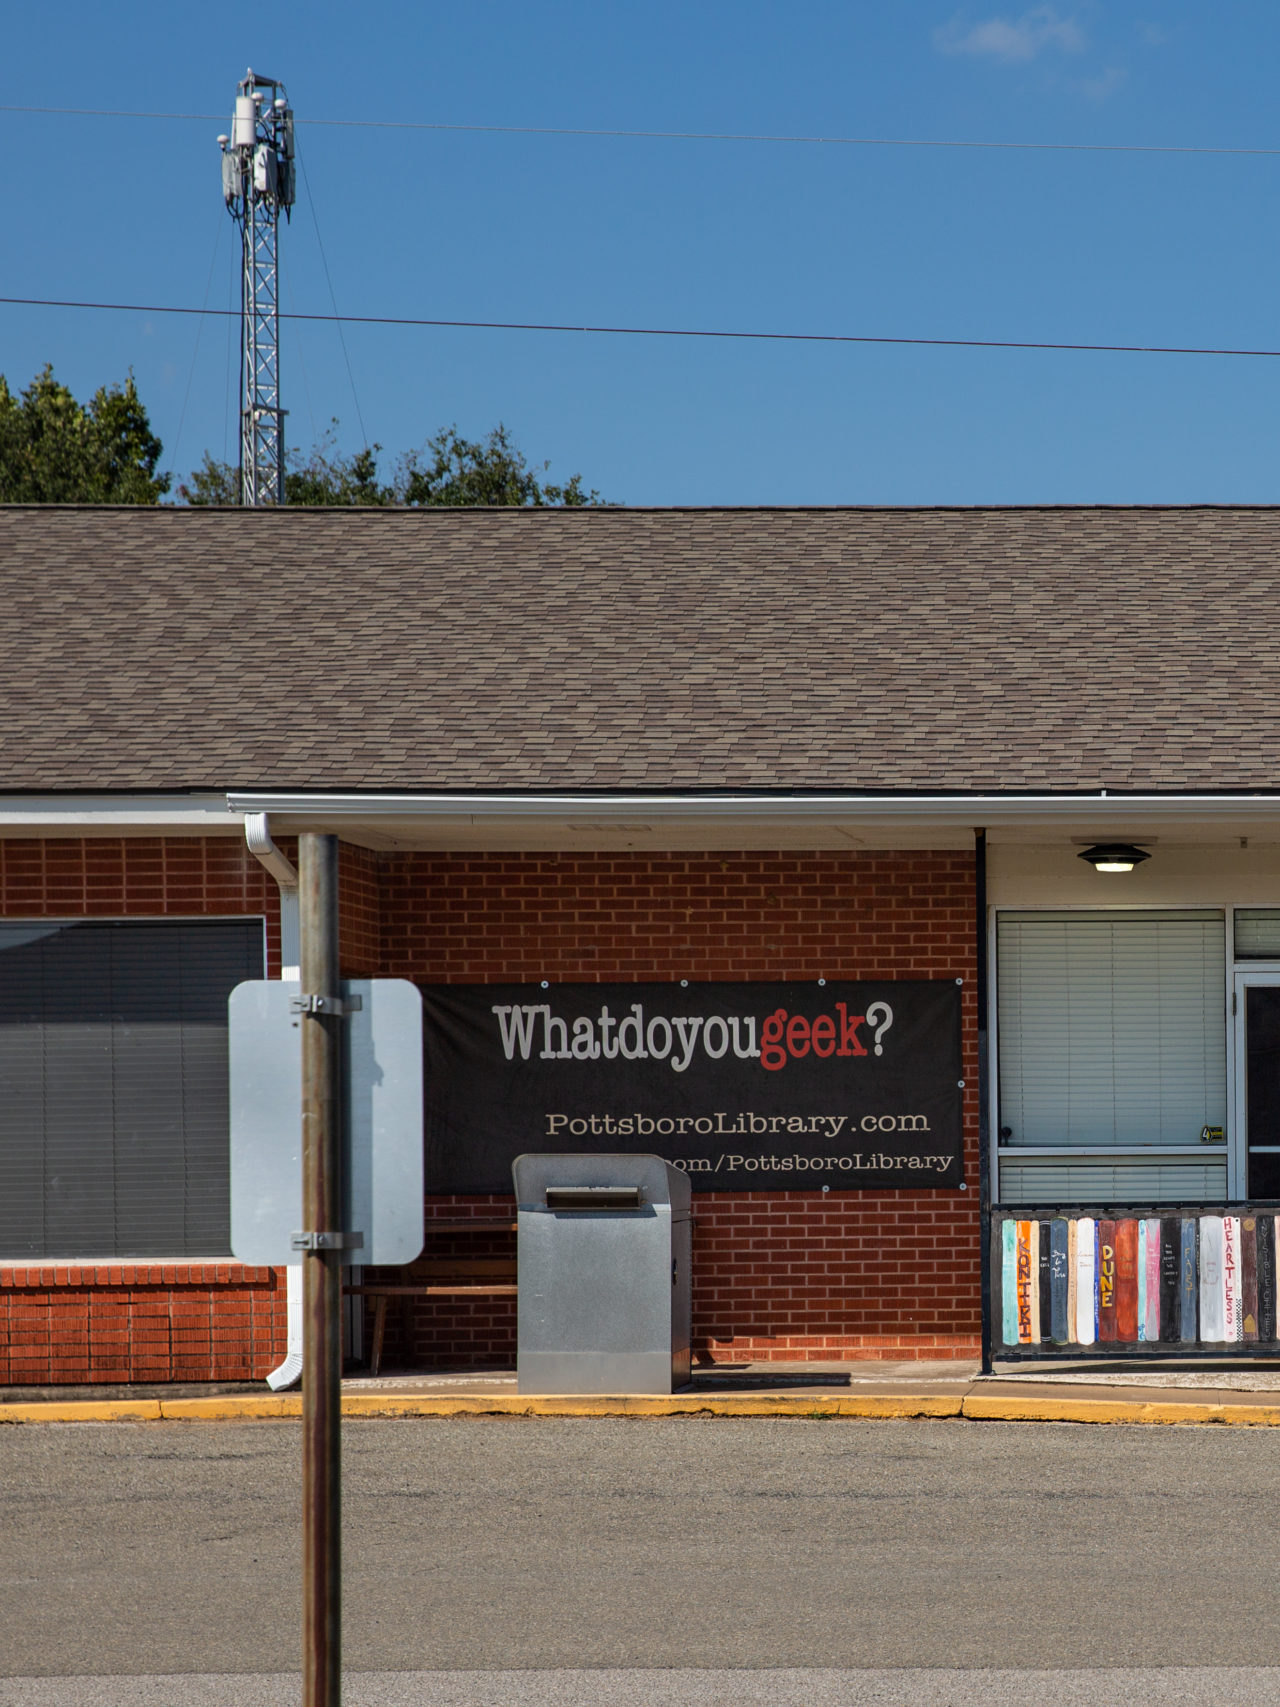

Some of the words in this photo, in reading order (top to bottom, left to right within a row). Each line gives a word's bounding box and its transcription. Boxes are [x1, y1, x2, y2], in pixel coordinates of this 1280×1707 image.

[545, 1111, 932, 1139] PottsboroLibrary.com
[665, 1152, 956, 1174] om/PottsboroLibrary
[1100, 1245, 1114, 1308] DUNE
[1223, 1217, 1235, 1324] HEARTLESS
